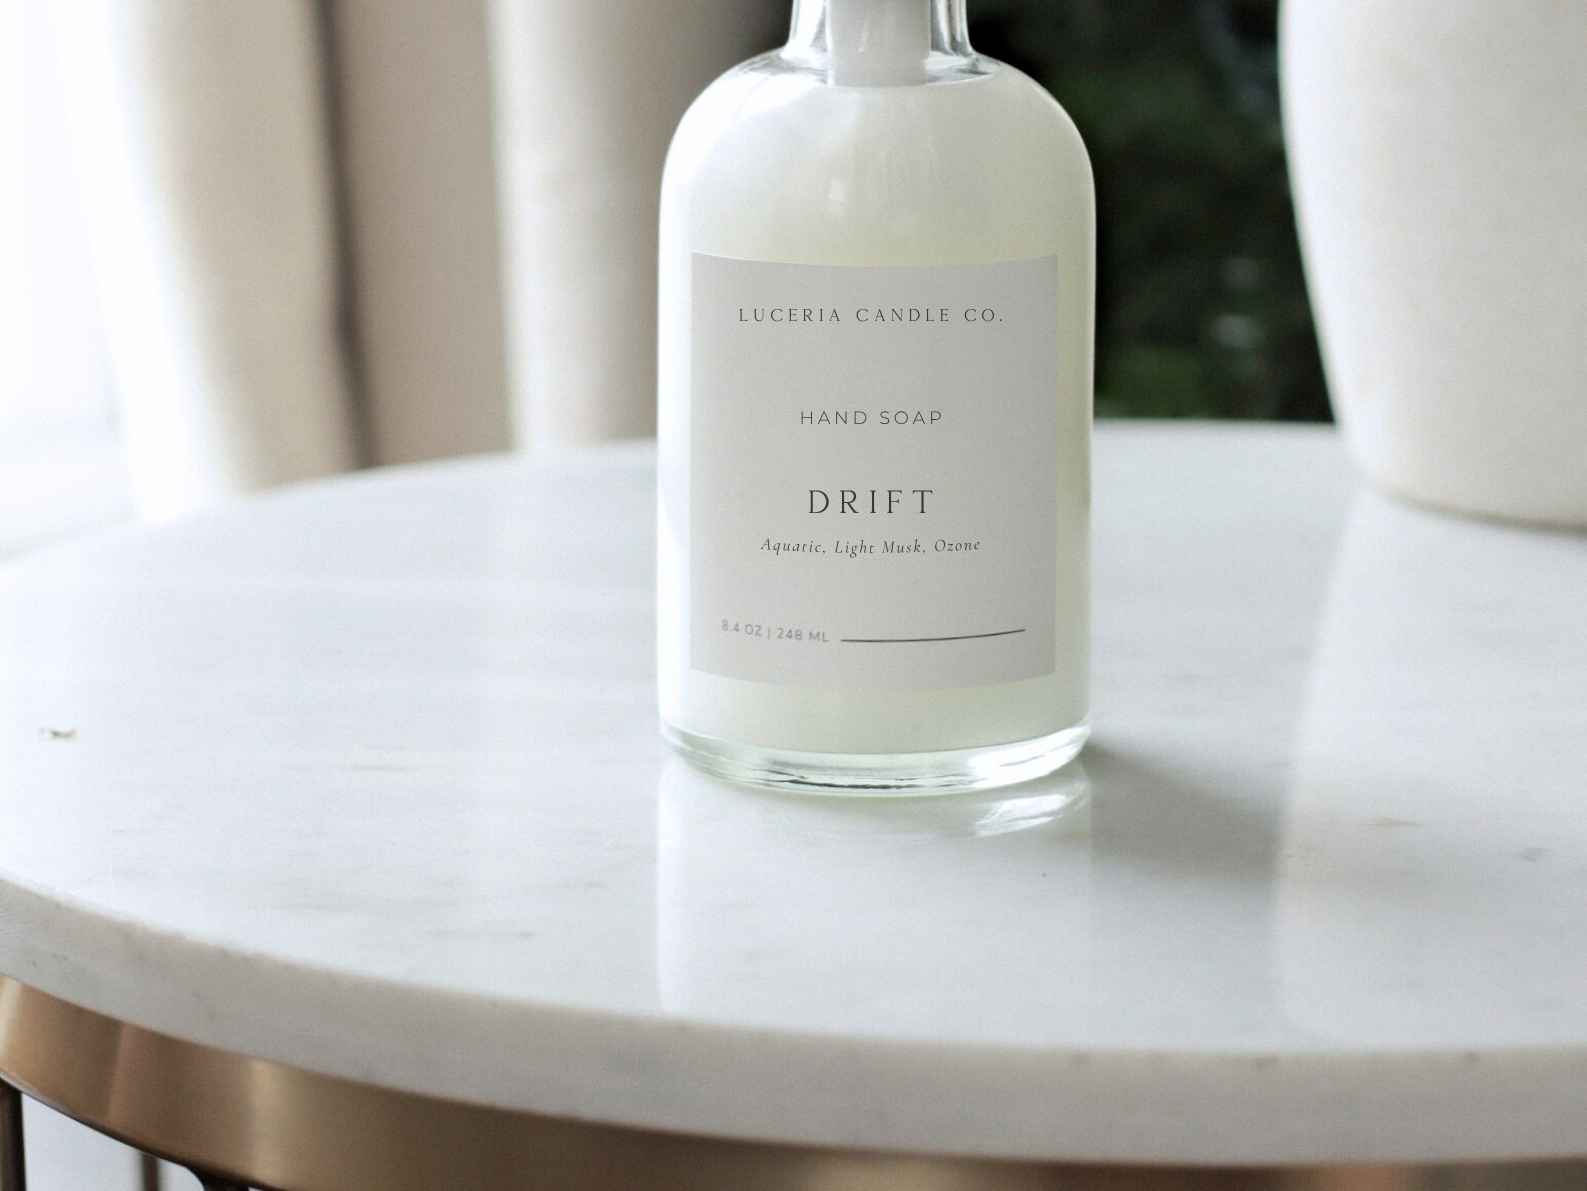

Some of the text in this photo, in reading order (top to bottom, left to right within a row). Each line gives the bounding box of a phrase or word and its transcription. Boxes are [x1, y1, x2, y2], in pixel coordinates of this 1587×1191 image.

[738, 308, 1003, 323] LUCERIA CANDLE CO.
[800, 410, 942, 425] HAND SOAP
[808, 489, 934, 514] DRIFT
[760, 537, 981, 558] Aquatic, Light Musk, Ozone
[721, 619, 740, 633] 8.4
[744, 623, 763, 637] OZ
[776, 627, 803, 642] 248
[808, 629, 830, 643] ML
